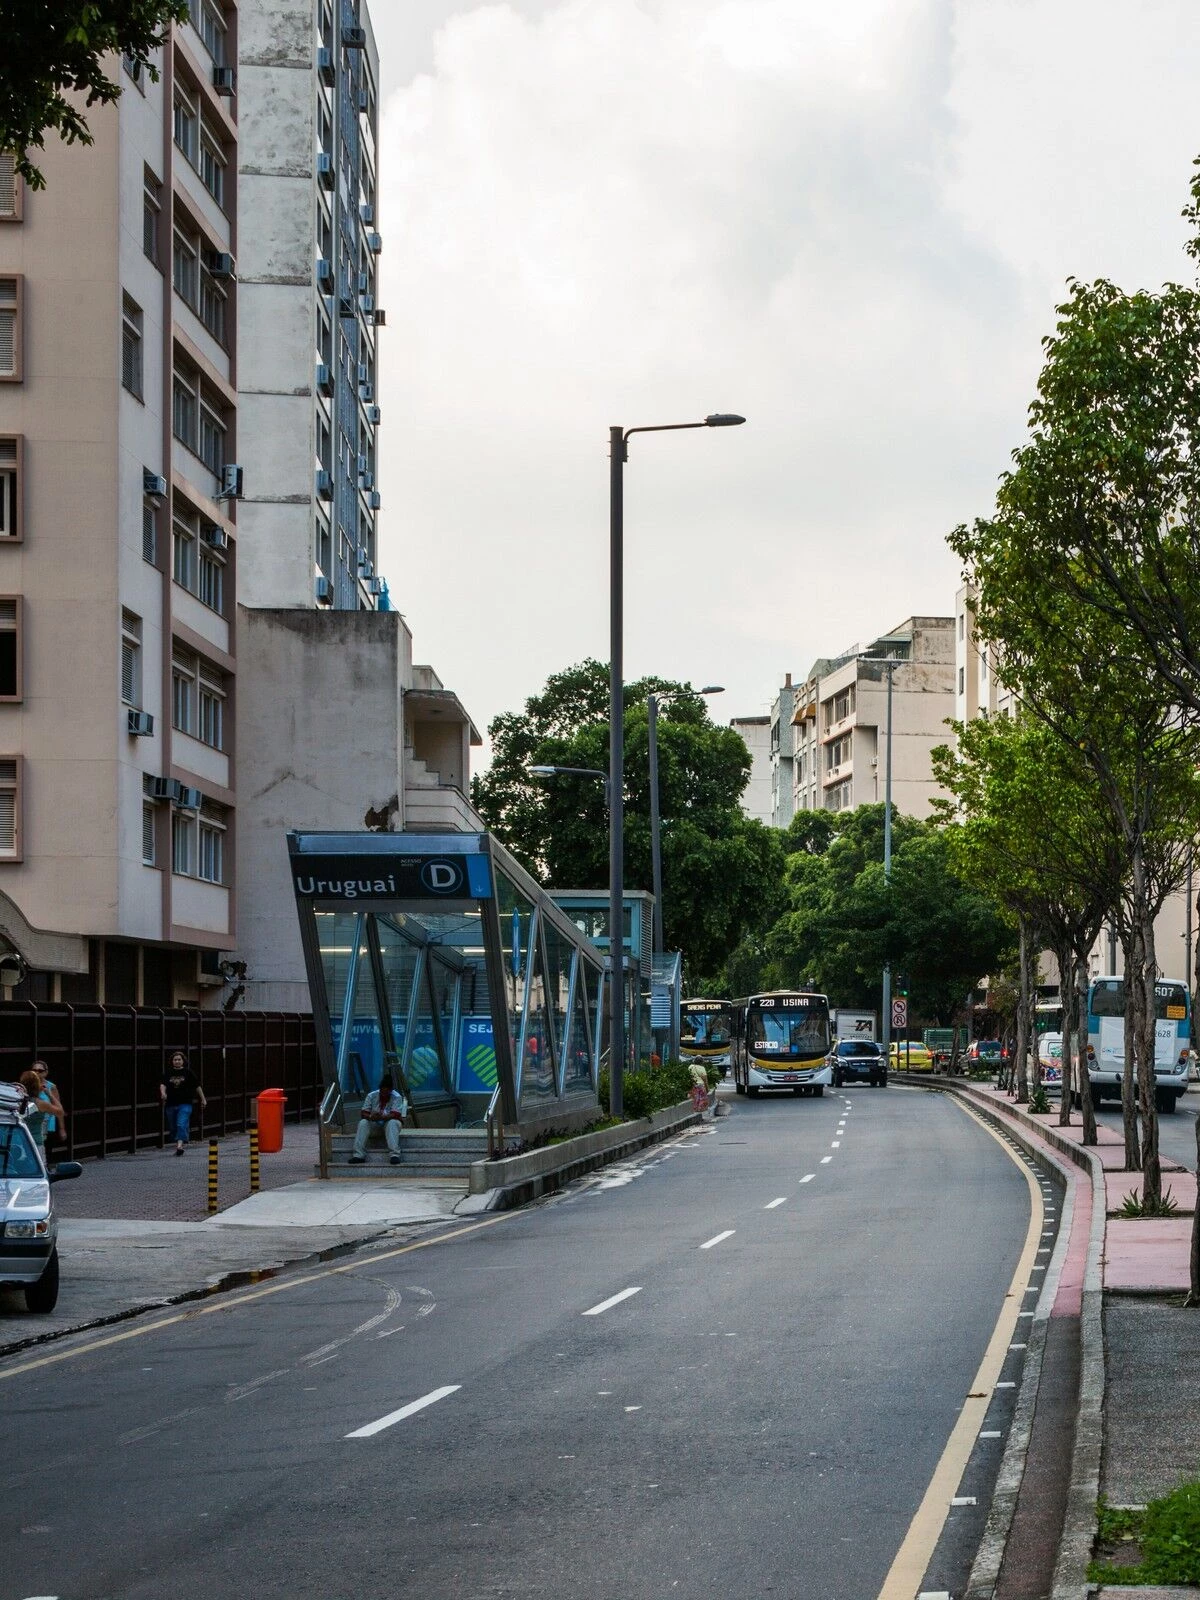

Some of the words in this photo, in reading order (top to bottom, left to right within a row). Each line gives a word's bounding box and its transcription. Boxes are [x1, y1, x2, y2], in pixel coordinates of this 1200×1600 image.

[430, 864, 456, 888] D
[297, 875, 395, 898] Uruguai
[759, 999, 775, 1007] 220
[782, 998, 809, 1007] USINA
[468, 1023, 494, 1034] SEJ
[855, 1020, 872, 1031] TA
